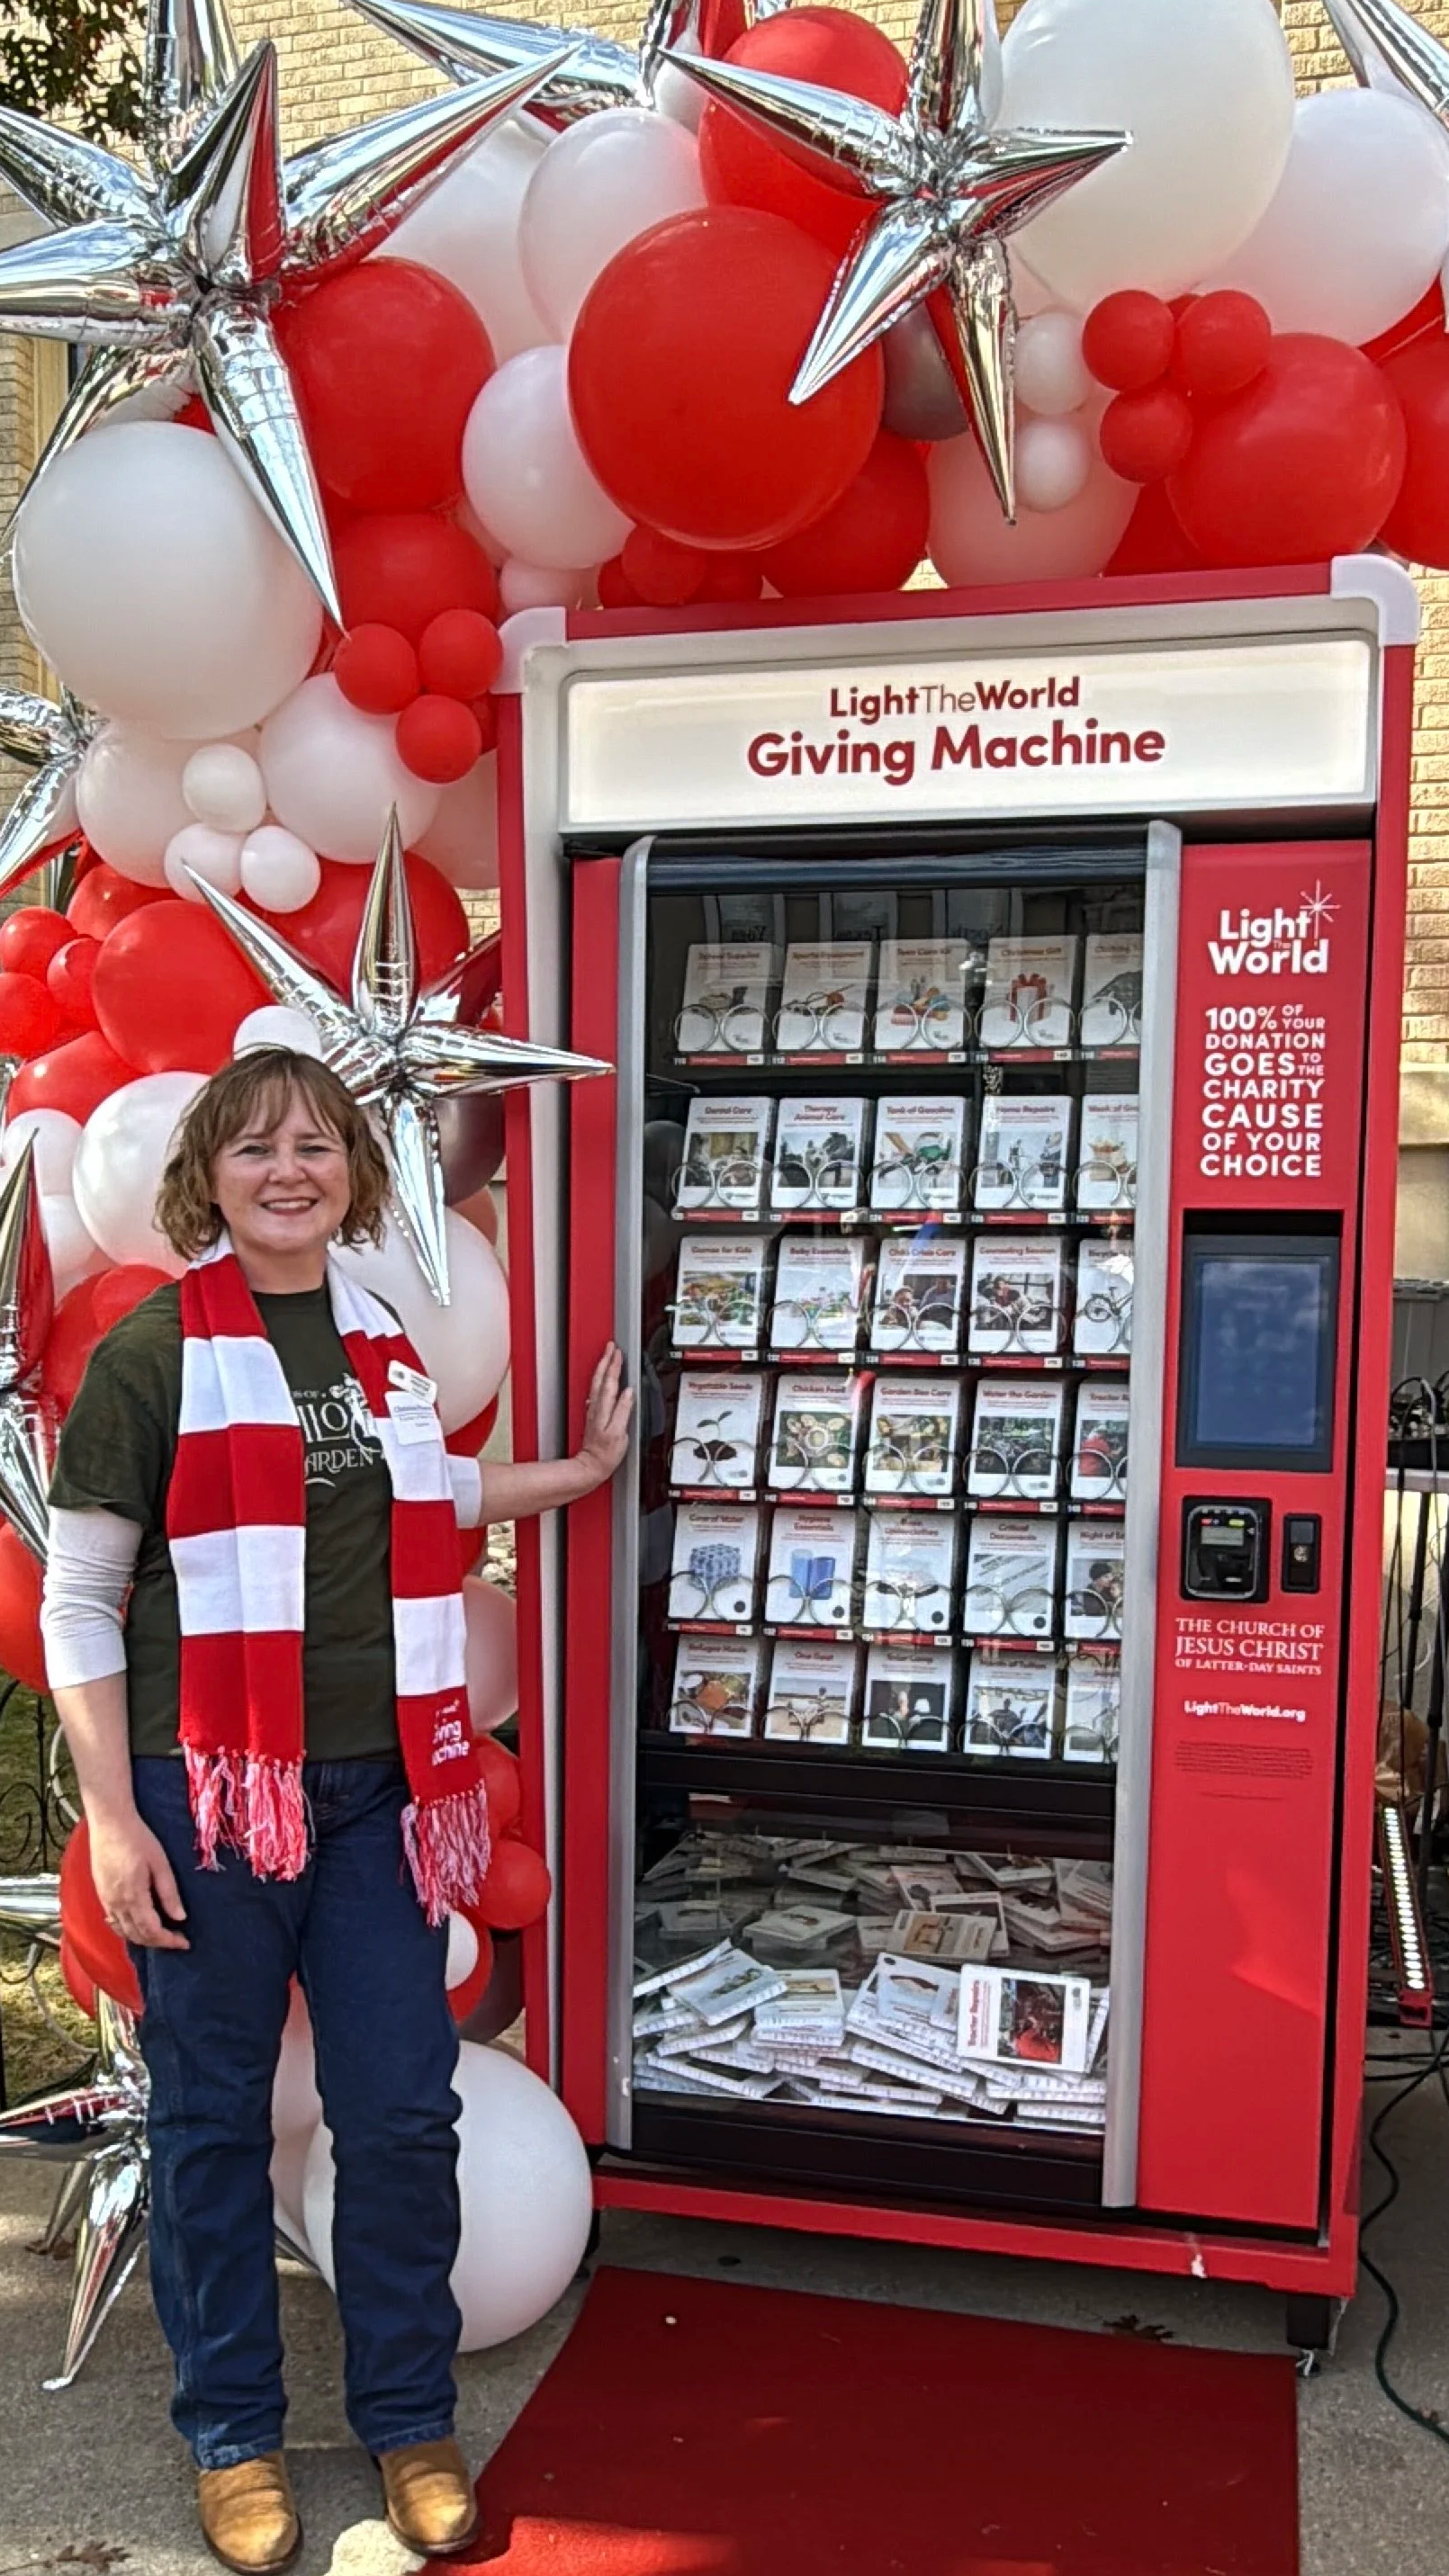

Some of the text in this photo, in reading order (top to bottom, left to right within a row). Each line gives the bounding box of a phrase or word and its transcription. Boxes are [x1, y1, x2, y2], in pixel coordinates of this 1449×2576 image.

[830, 676, 1080, 725] LightTheWorld
[748, 719, 1166, 785] Giving Machine
[1220, 907, 1311, 947] Light
[1208, 938, 1329, 974] World
[1205, 1004, 1303, 1030] 100% OF
[1282, 1018, 1325, 1029] YOUR
[1206, 1032, 1326, 1049] DONATION
[1204, 1053, 1321, 1076] GOES TO
[1298, 1065, 1324, 1076] THE
[1202, 1079, 1324, 1099] CHARITY
[1202, 1103, 1323, 1129] CAUSE
[1202, 1132, 1321, 1152] OF YOUR
[1200, 1154, 1322, 1177] CHOICE
[304, 1448, 374, 1478] ARDEN
[1175, 1618, 1325, 1638] THE CHURCH OF
[1174, 1636, 1324, 1661] JESUS CHRIST
[1174, 1658, 1322, 1675] OF LATTER-DAY SAINTS
[1184, 1700, 1306, 1723] LightTheWorld.org
